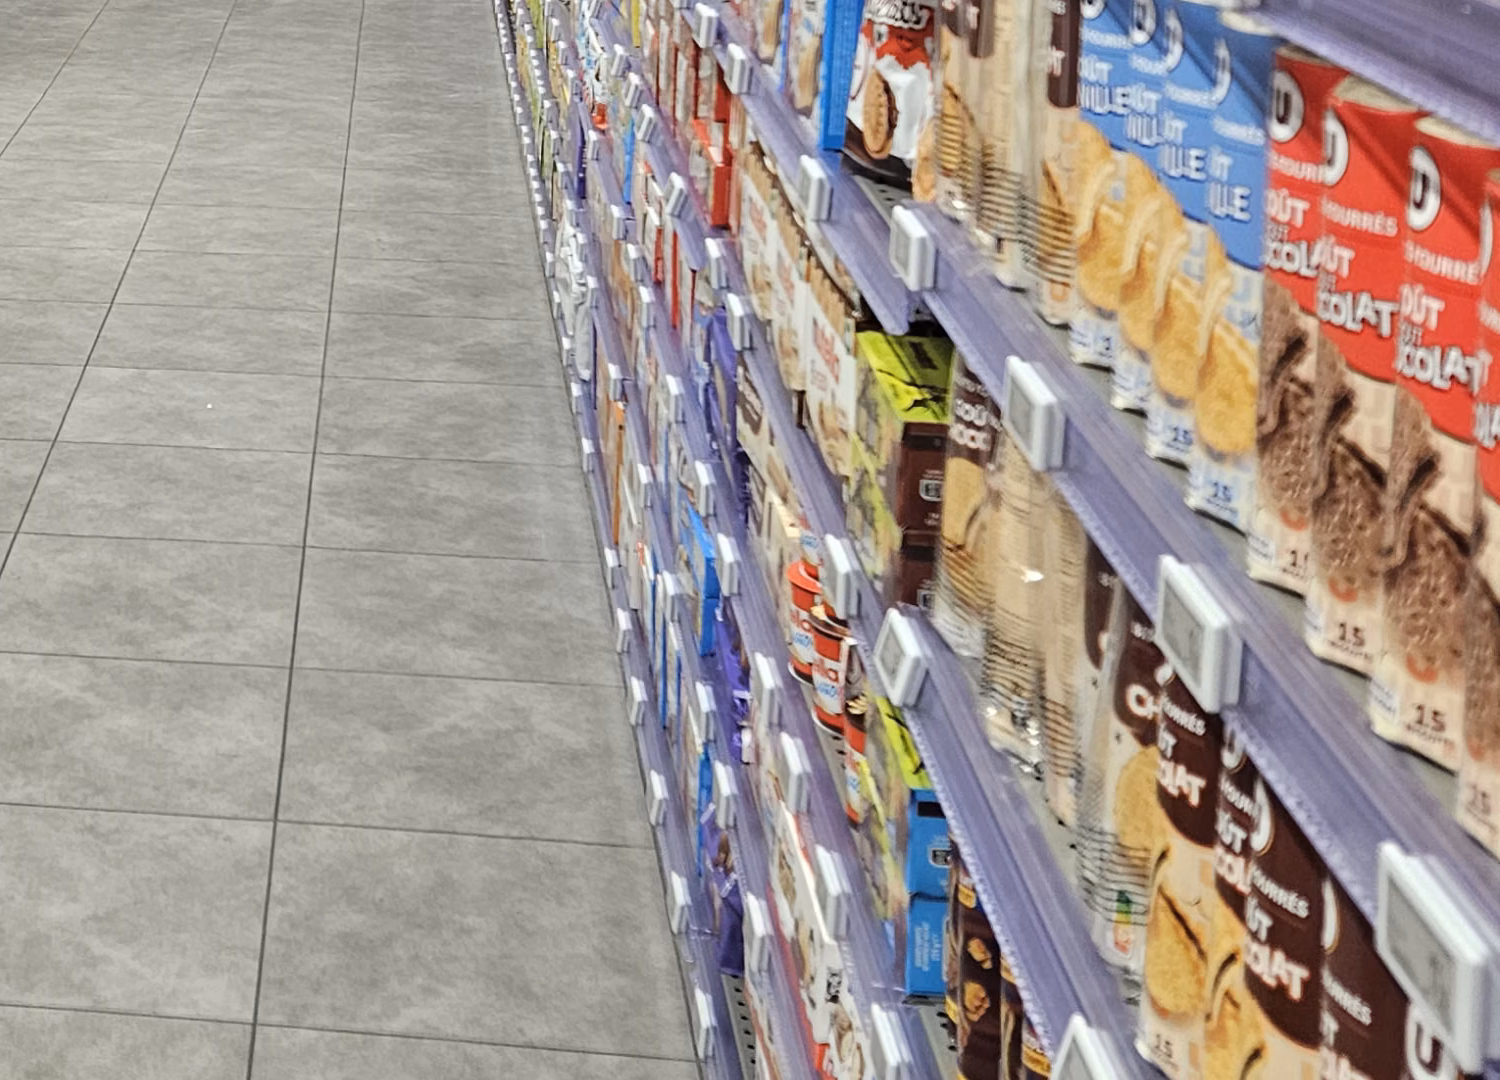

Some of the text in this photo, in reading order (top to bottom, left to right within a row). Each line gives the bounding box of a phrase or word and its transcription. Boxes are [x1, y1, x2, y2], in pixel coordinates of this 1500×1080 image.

[1317, 290, 1398, 337] COLAT
[1339, 622, 1366, 647] 15
[1416, 704, 1447, 732] 15
